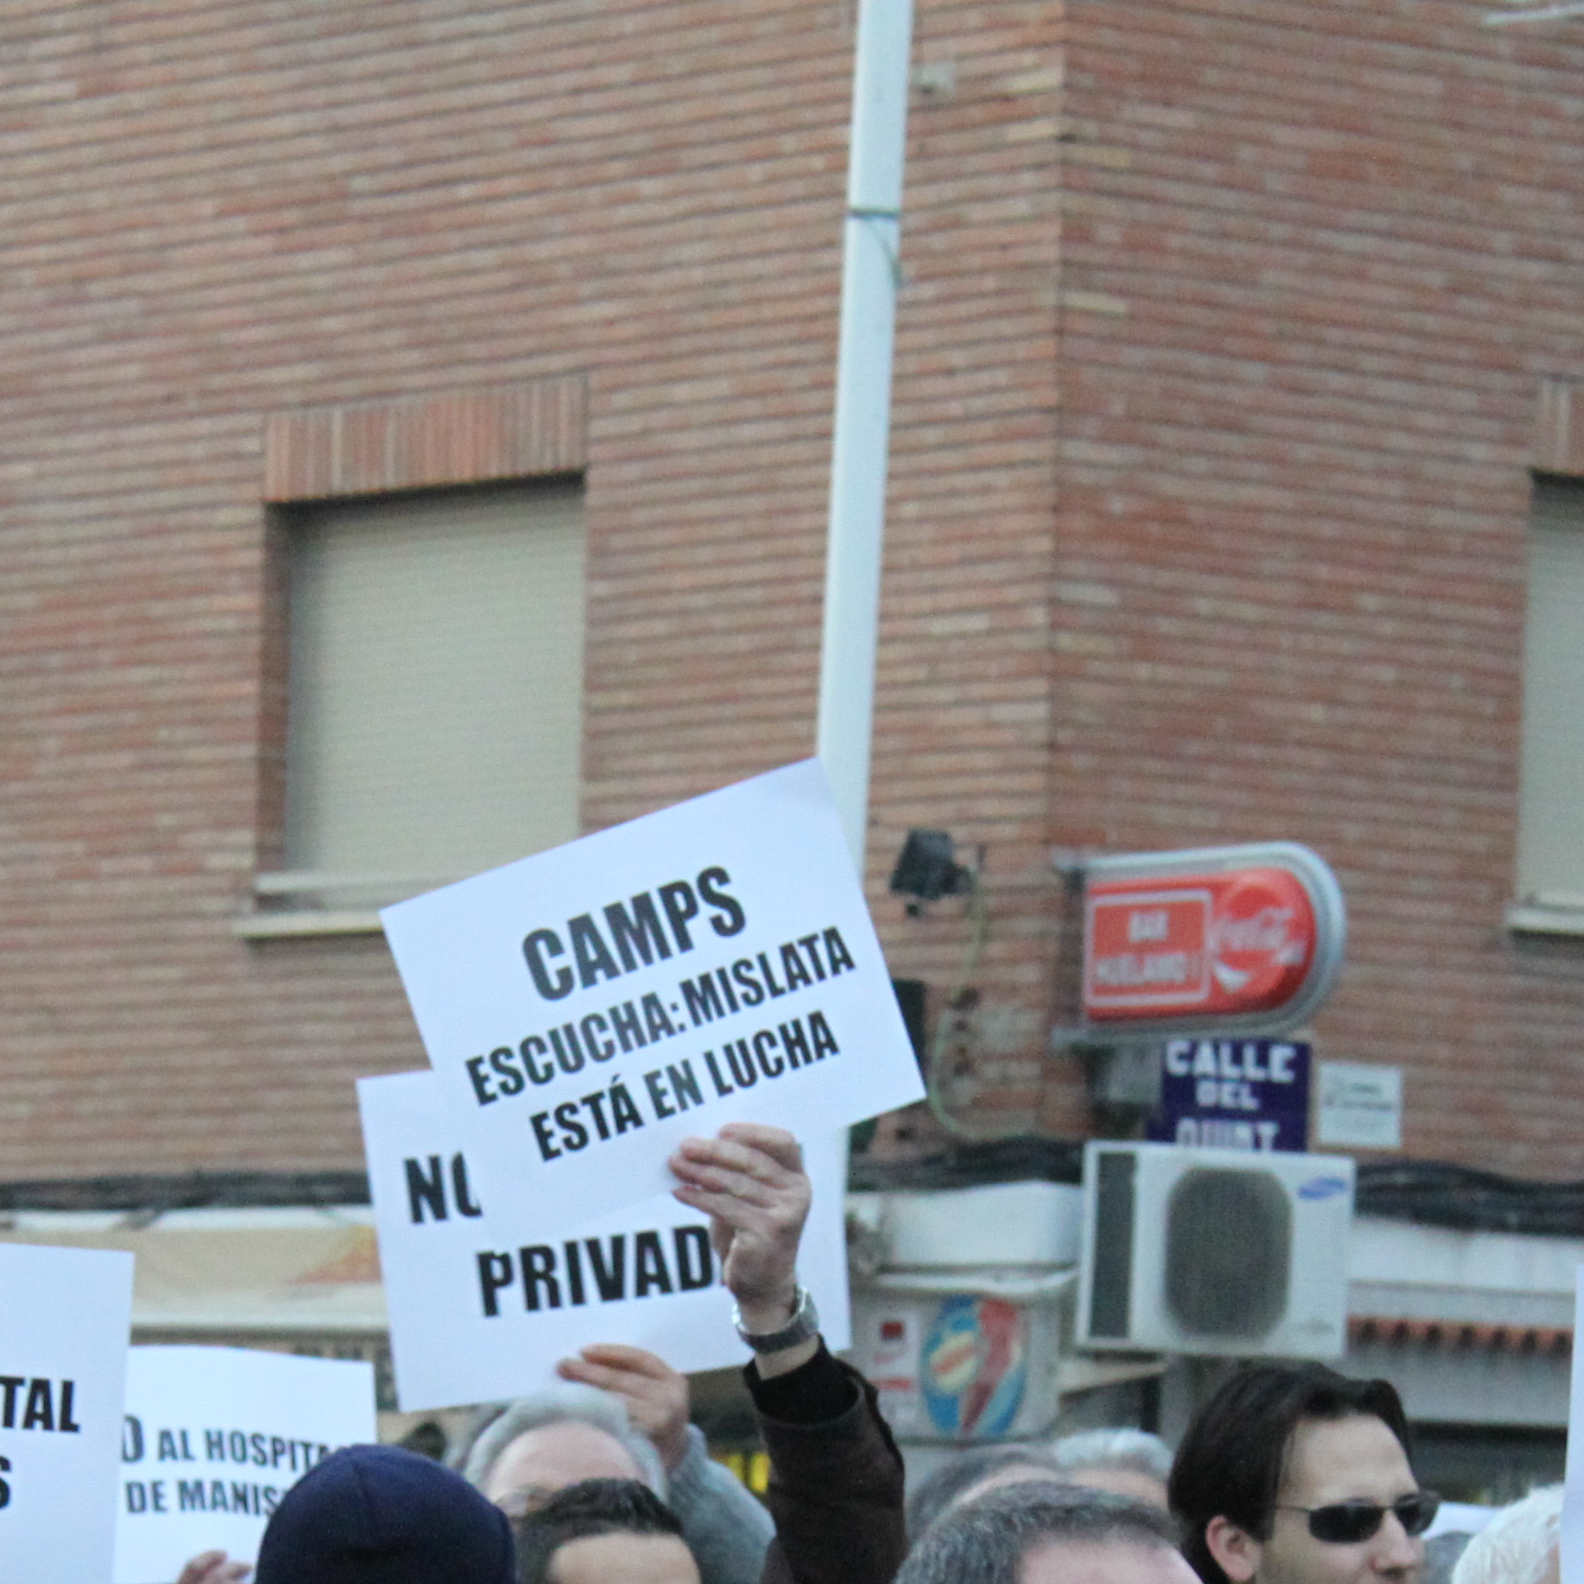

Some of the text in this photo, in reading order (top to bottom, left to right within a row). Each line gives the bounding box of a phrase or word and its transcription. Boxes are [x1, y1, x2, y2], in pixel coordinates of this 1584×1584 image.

[522, 865, 747, 1002] CAMPS
[678, 925, 857, 1028] MISLATA
[528, 1009, 841, 1162] ESTÁ EN LUCHA
[1164, 1038, 1297, 1084] CALLE
[1195, 1080, 1259, 1110] DEL
[476, 1225, 716, 1318] PRIVAD
[158, 1429, 195, 1462] AL
[125, 1479, 281, 1518] DE MANIS
